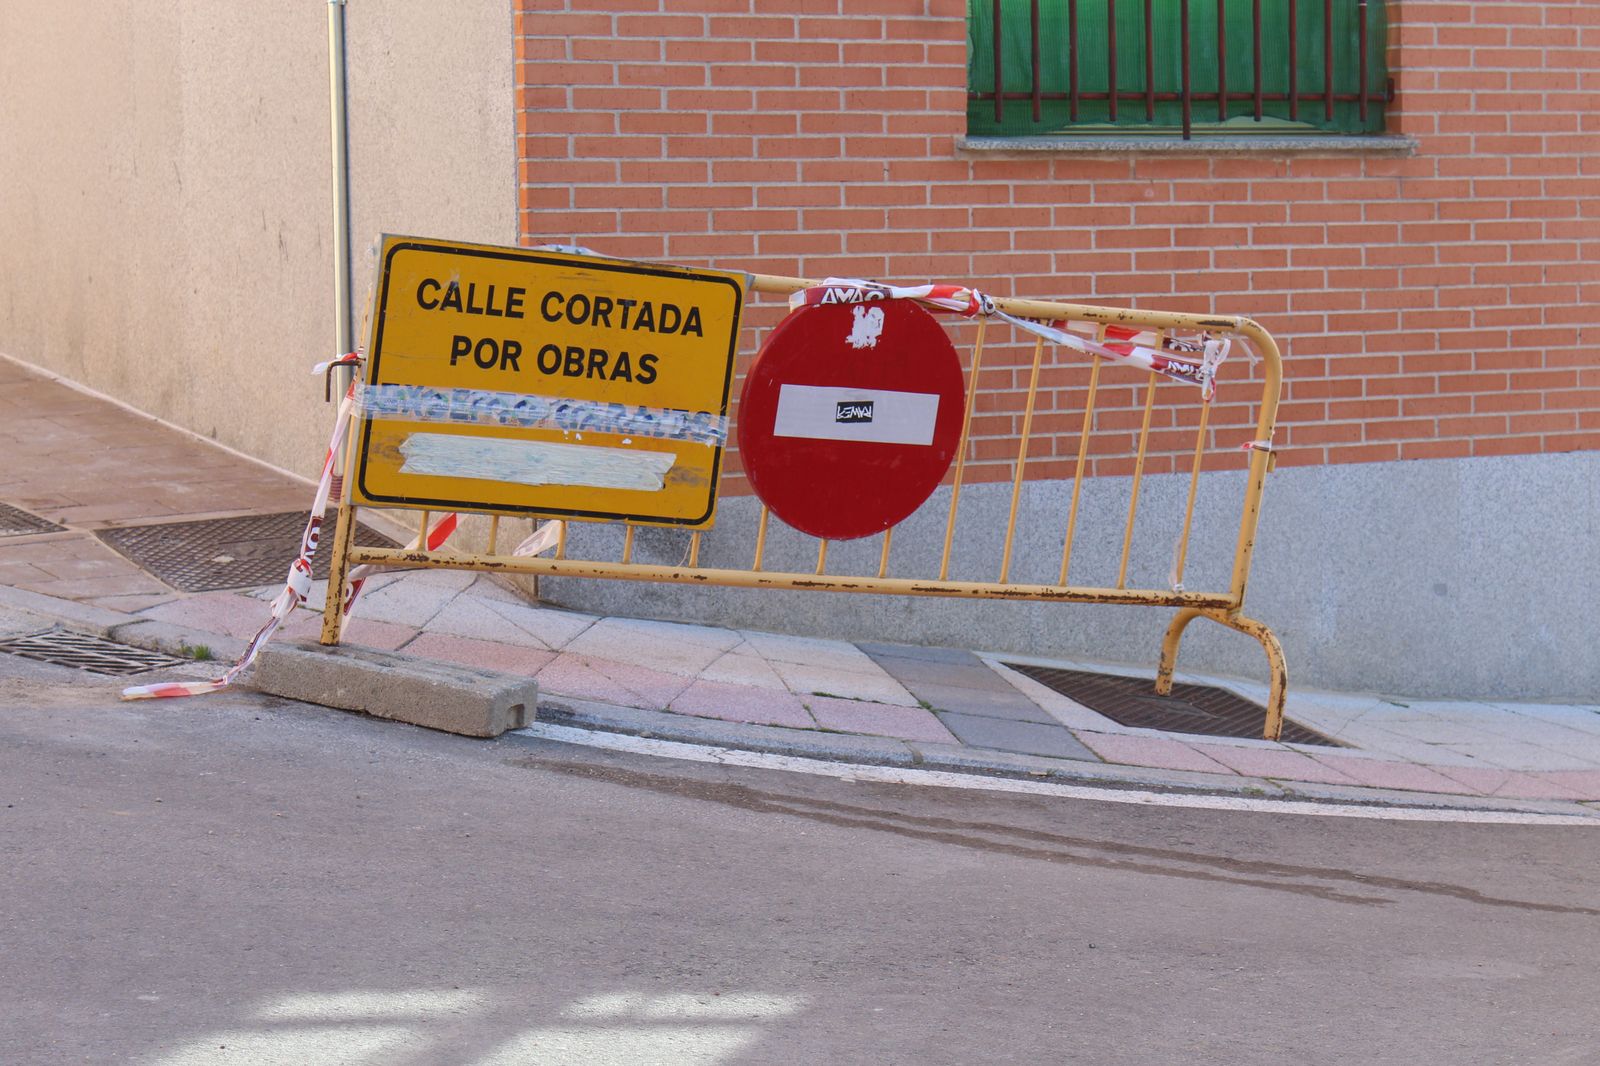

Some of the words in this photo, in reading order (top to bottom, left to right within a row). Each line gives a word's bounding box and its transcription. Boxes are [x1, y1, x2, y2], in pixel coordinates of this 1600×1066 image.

[416, 278, 526, 319] CALLE
[540, 290, 704, 338] CORTADA
[449, 335, 523, 372] POR
[537, 343, 660, 385] OBRAS
